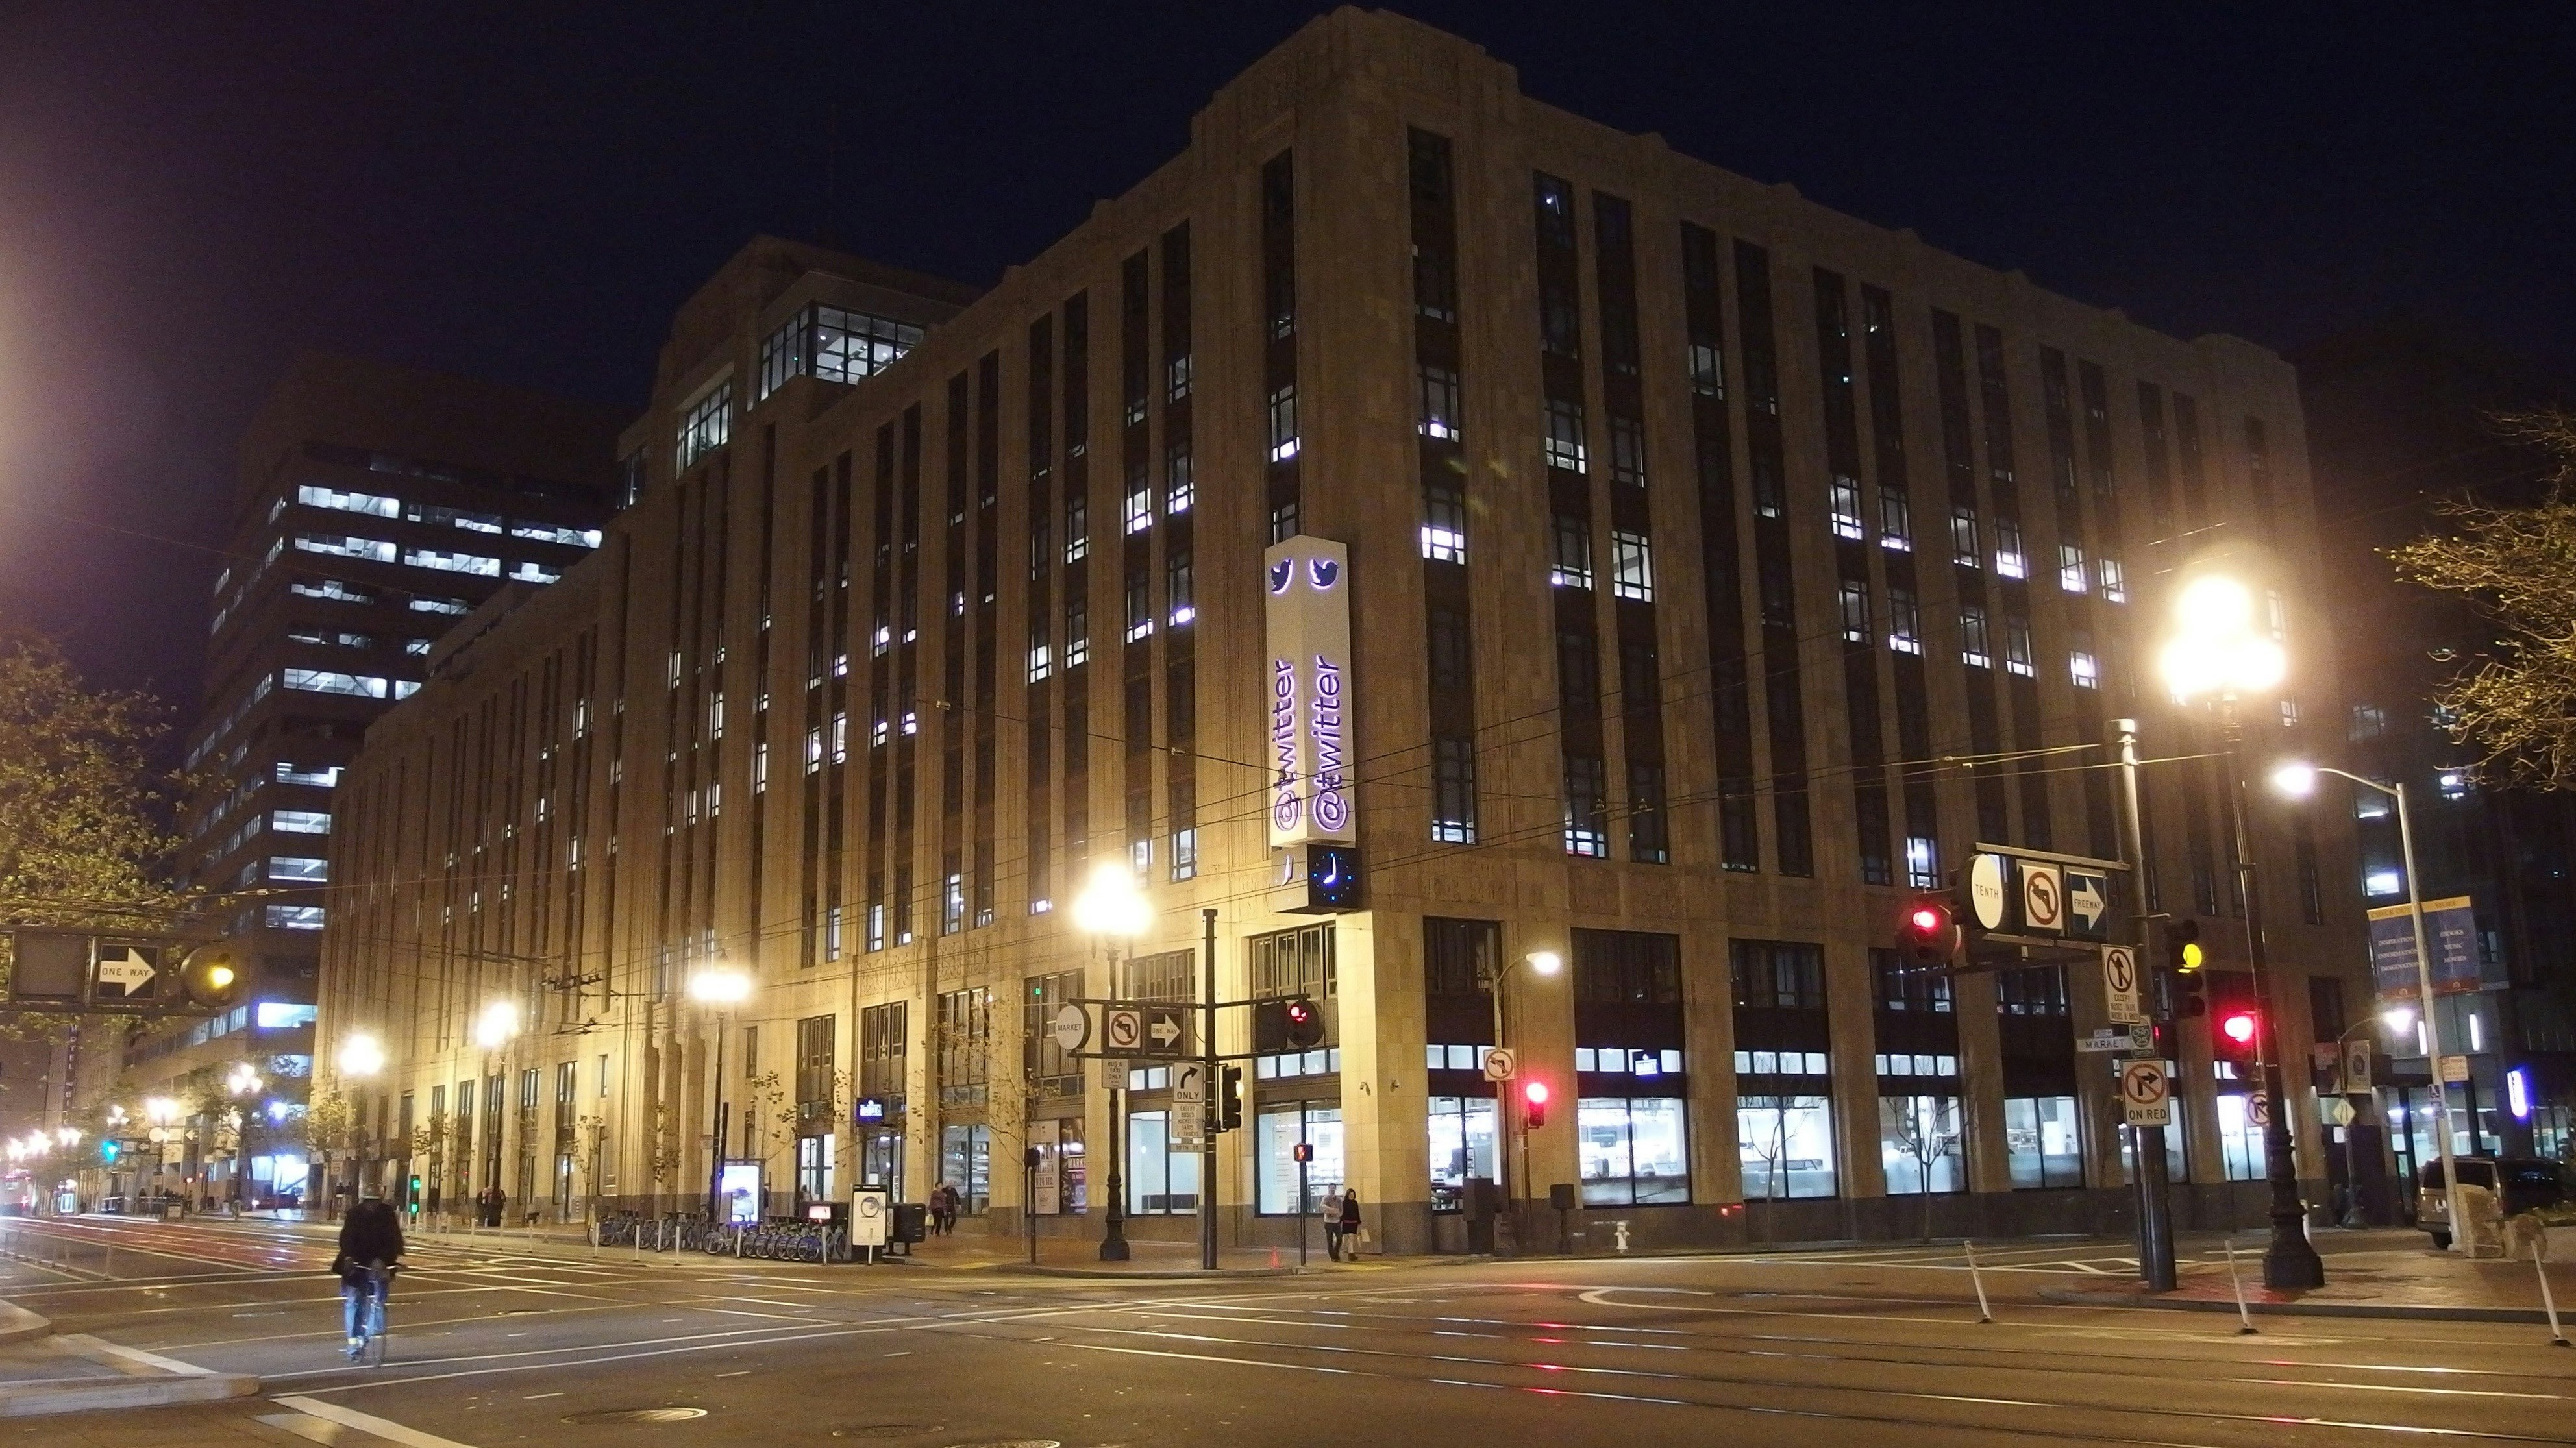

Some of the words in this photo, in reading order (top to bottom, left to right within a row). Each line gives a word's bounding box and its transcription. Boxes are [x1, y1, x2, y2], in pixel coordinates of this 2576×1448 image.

[1272, 659, 1302, 832] @twitter
[1312, 654, 1349, 833] @twitter
[1975, 883, 1999, 900] TENTH
[2074, 898, 2101, 909] FREEWAY
[2085, 1039, 2125, 1048] MARKET
[1176, 1091, 1200, 1099] ONLY
[2129, 1109, 2143, 1120] ON
[2146, 1109, 2167, 1119] RED
